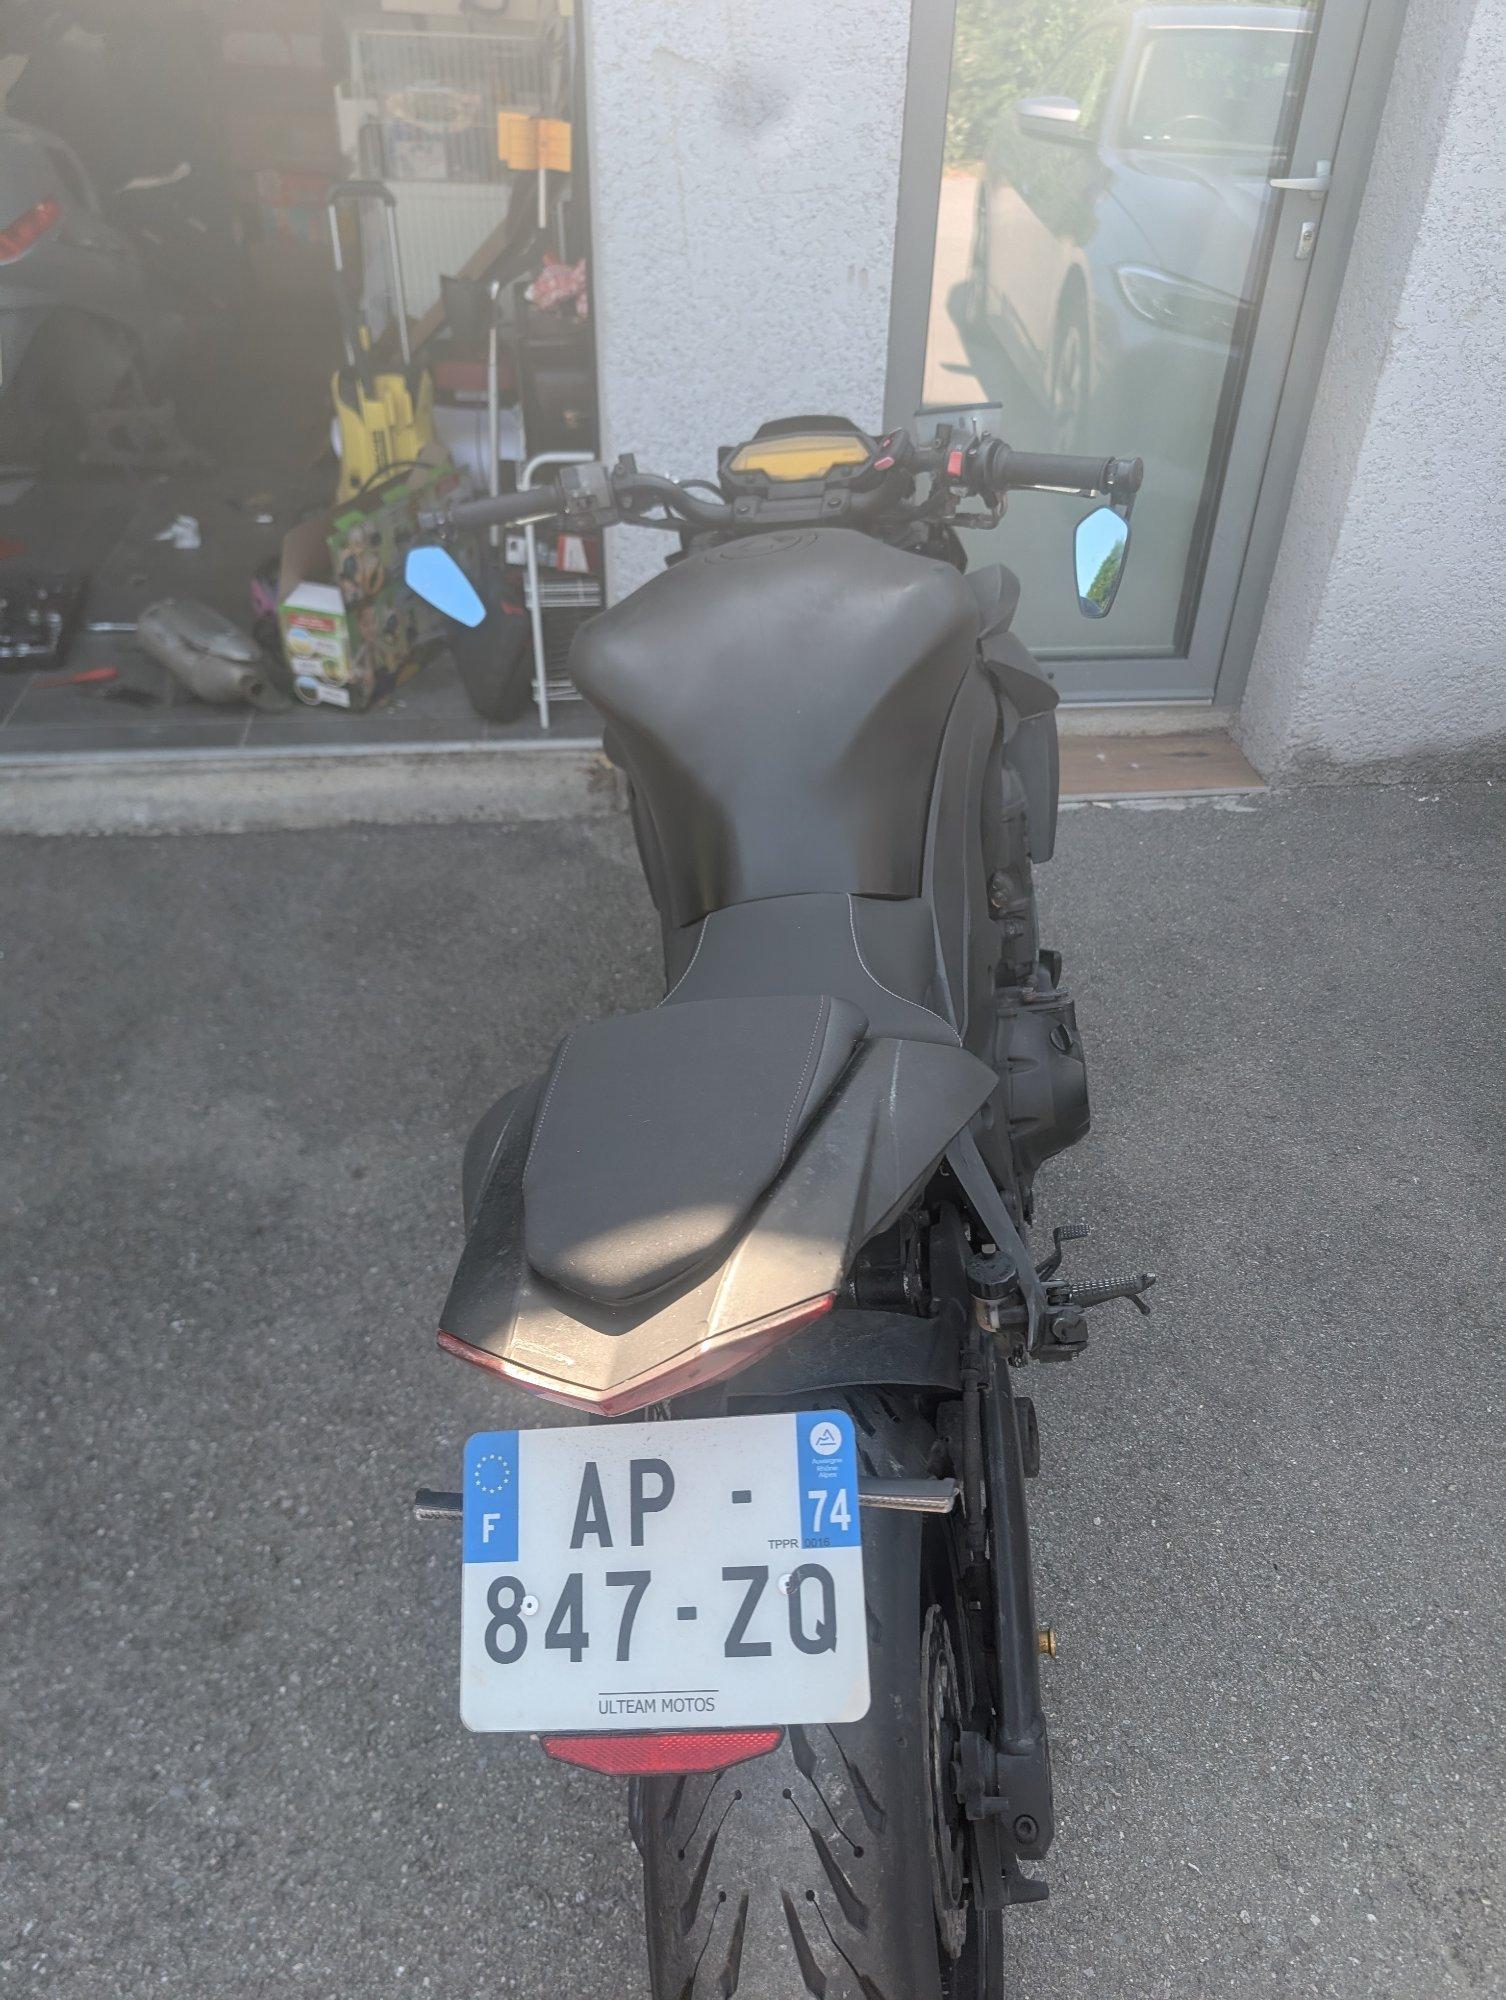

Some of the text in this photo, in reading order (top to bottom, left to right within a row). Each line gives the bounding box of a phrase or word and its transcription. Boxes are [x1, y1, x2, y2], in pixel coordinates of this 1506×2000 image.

[569, 1457, 675, 1549] AP
[808, 1488, 851, 1532] 74
[482, 1513, 501, 1543] F
[768, 1538, 799, 1549] TPPR
[599, 1697, 715, 1714] ULTEAM MOTOS
